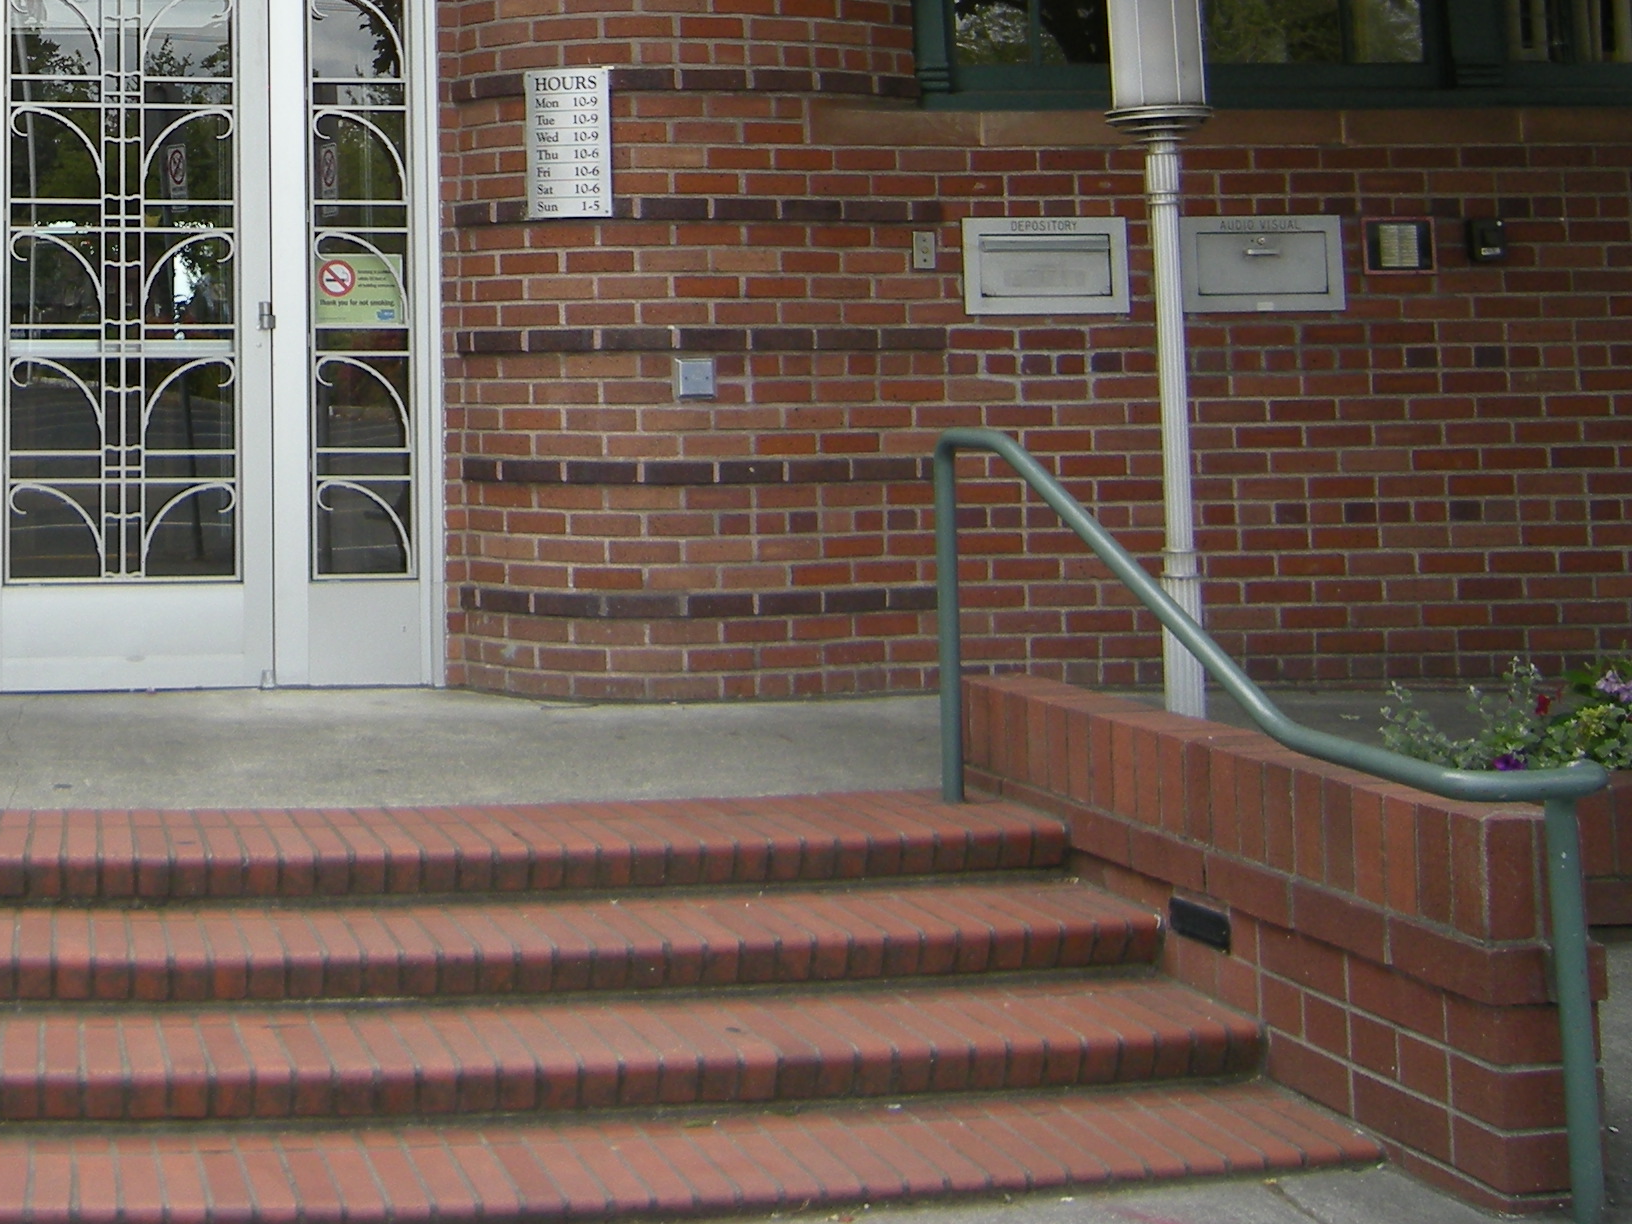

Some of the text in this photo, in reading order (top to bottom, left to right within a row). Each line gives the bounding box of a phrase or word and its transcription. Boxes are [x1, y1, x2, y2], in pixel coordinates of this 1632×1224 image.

[534, 75, 597, 92] HOURS
[534, 96, 598, 109] Mon 10-9
[535, 113, 598, 126] Tue 10-9
[536, 131, 599, 143] Wed 10-9
[536, 148, 600, 161] Thu 10-6
[536, 166, 600, 178] Fri 10-6
[536, 183, 601, 195] Sat 10-6
[537, 200, 601, 212] Sun 1-5
[1010, 220, 1078, 232] DEPOSITORY
[1219, 219, 1302, 230] AUDIO VISUAL
